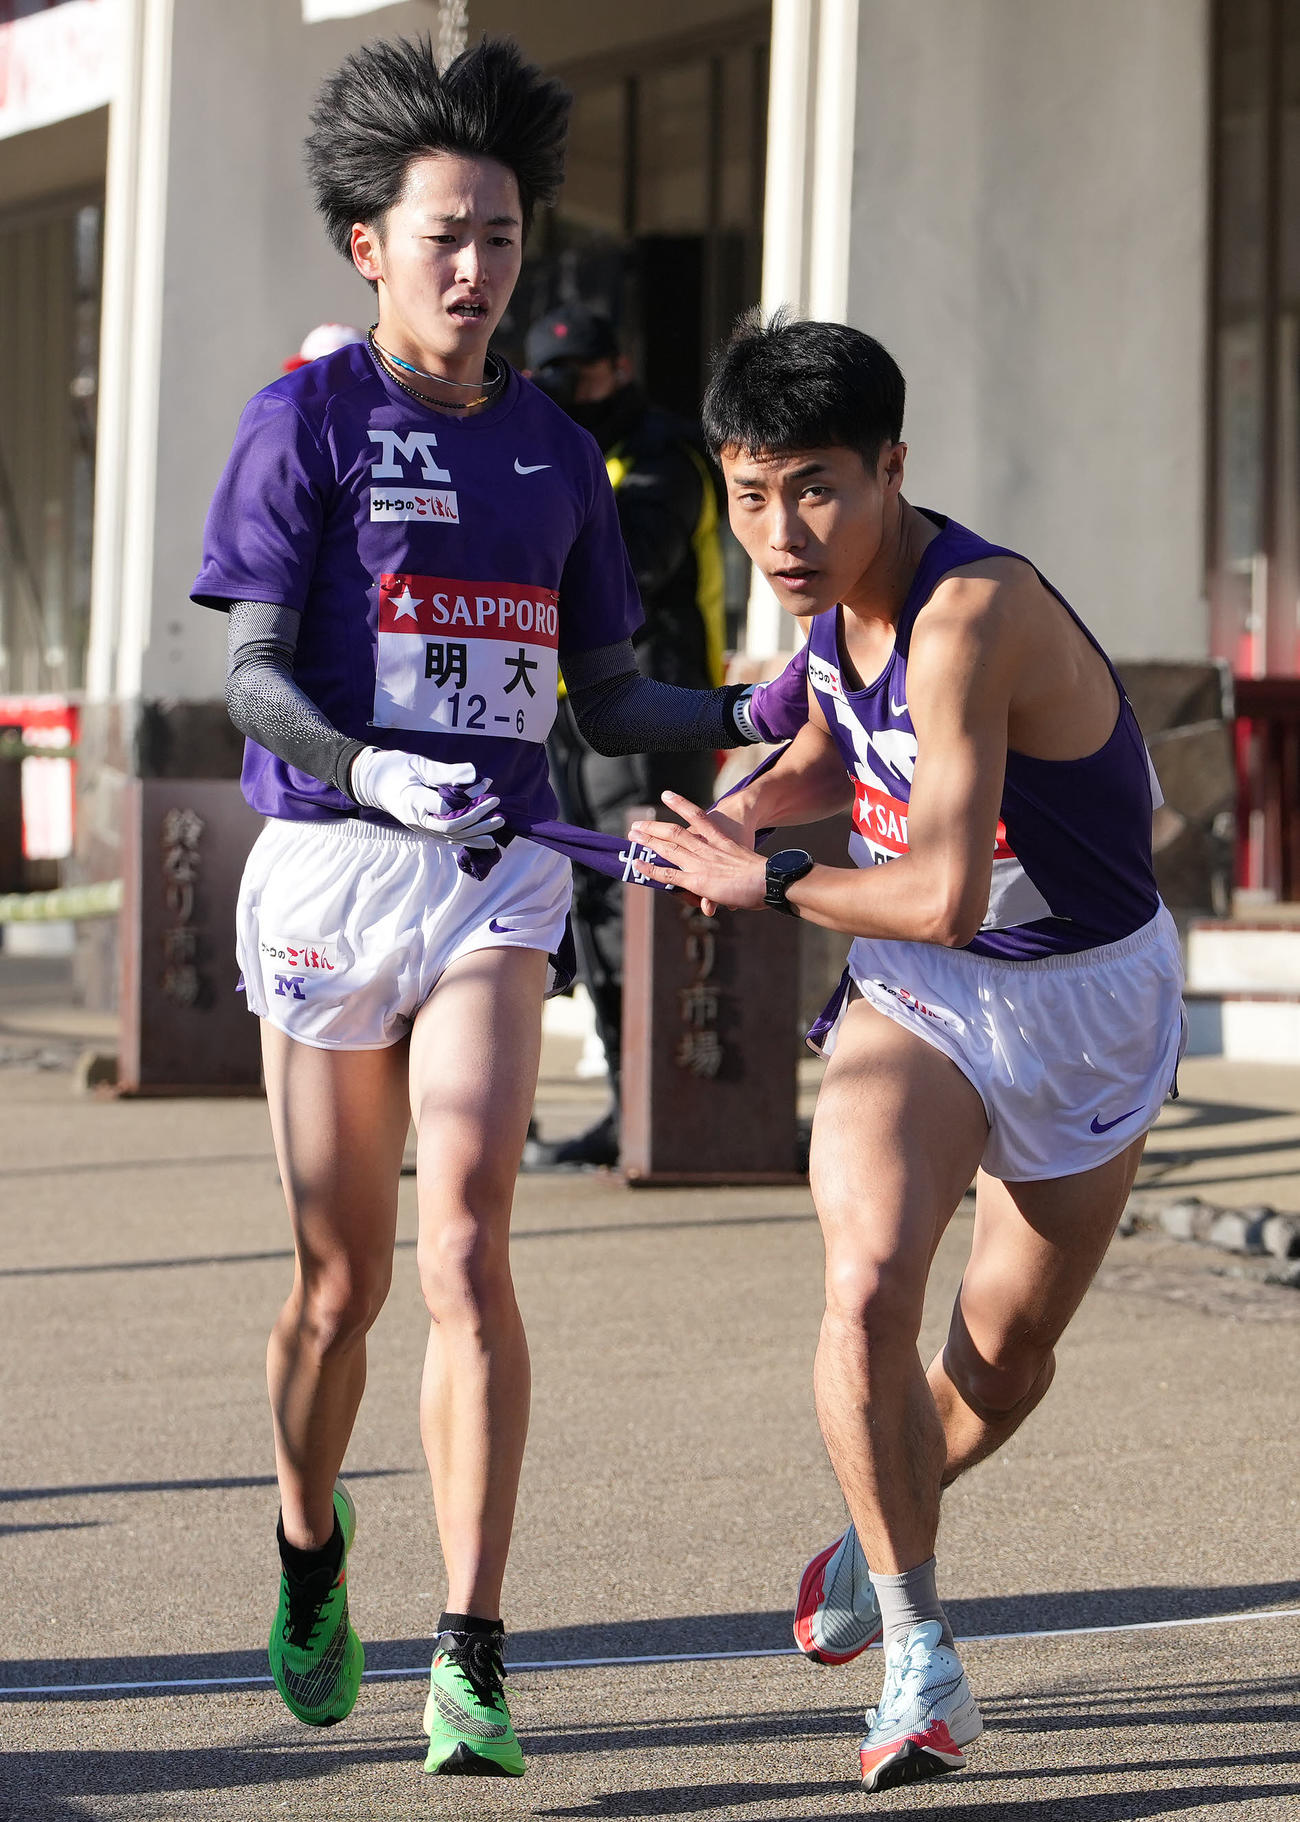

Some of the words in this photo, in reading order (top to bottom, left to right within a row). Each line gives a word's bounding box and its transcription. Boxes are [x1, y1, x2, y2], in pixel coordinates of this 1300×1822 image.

[367, 430, 451, 483] M
[373, 496, 457, 519] サトウのごはん
[432, 593, 557, 636] SAPPORO
[274, 974, 306, 1000] M
